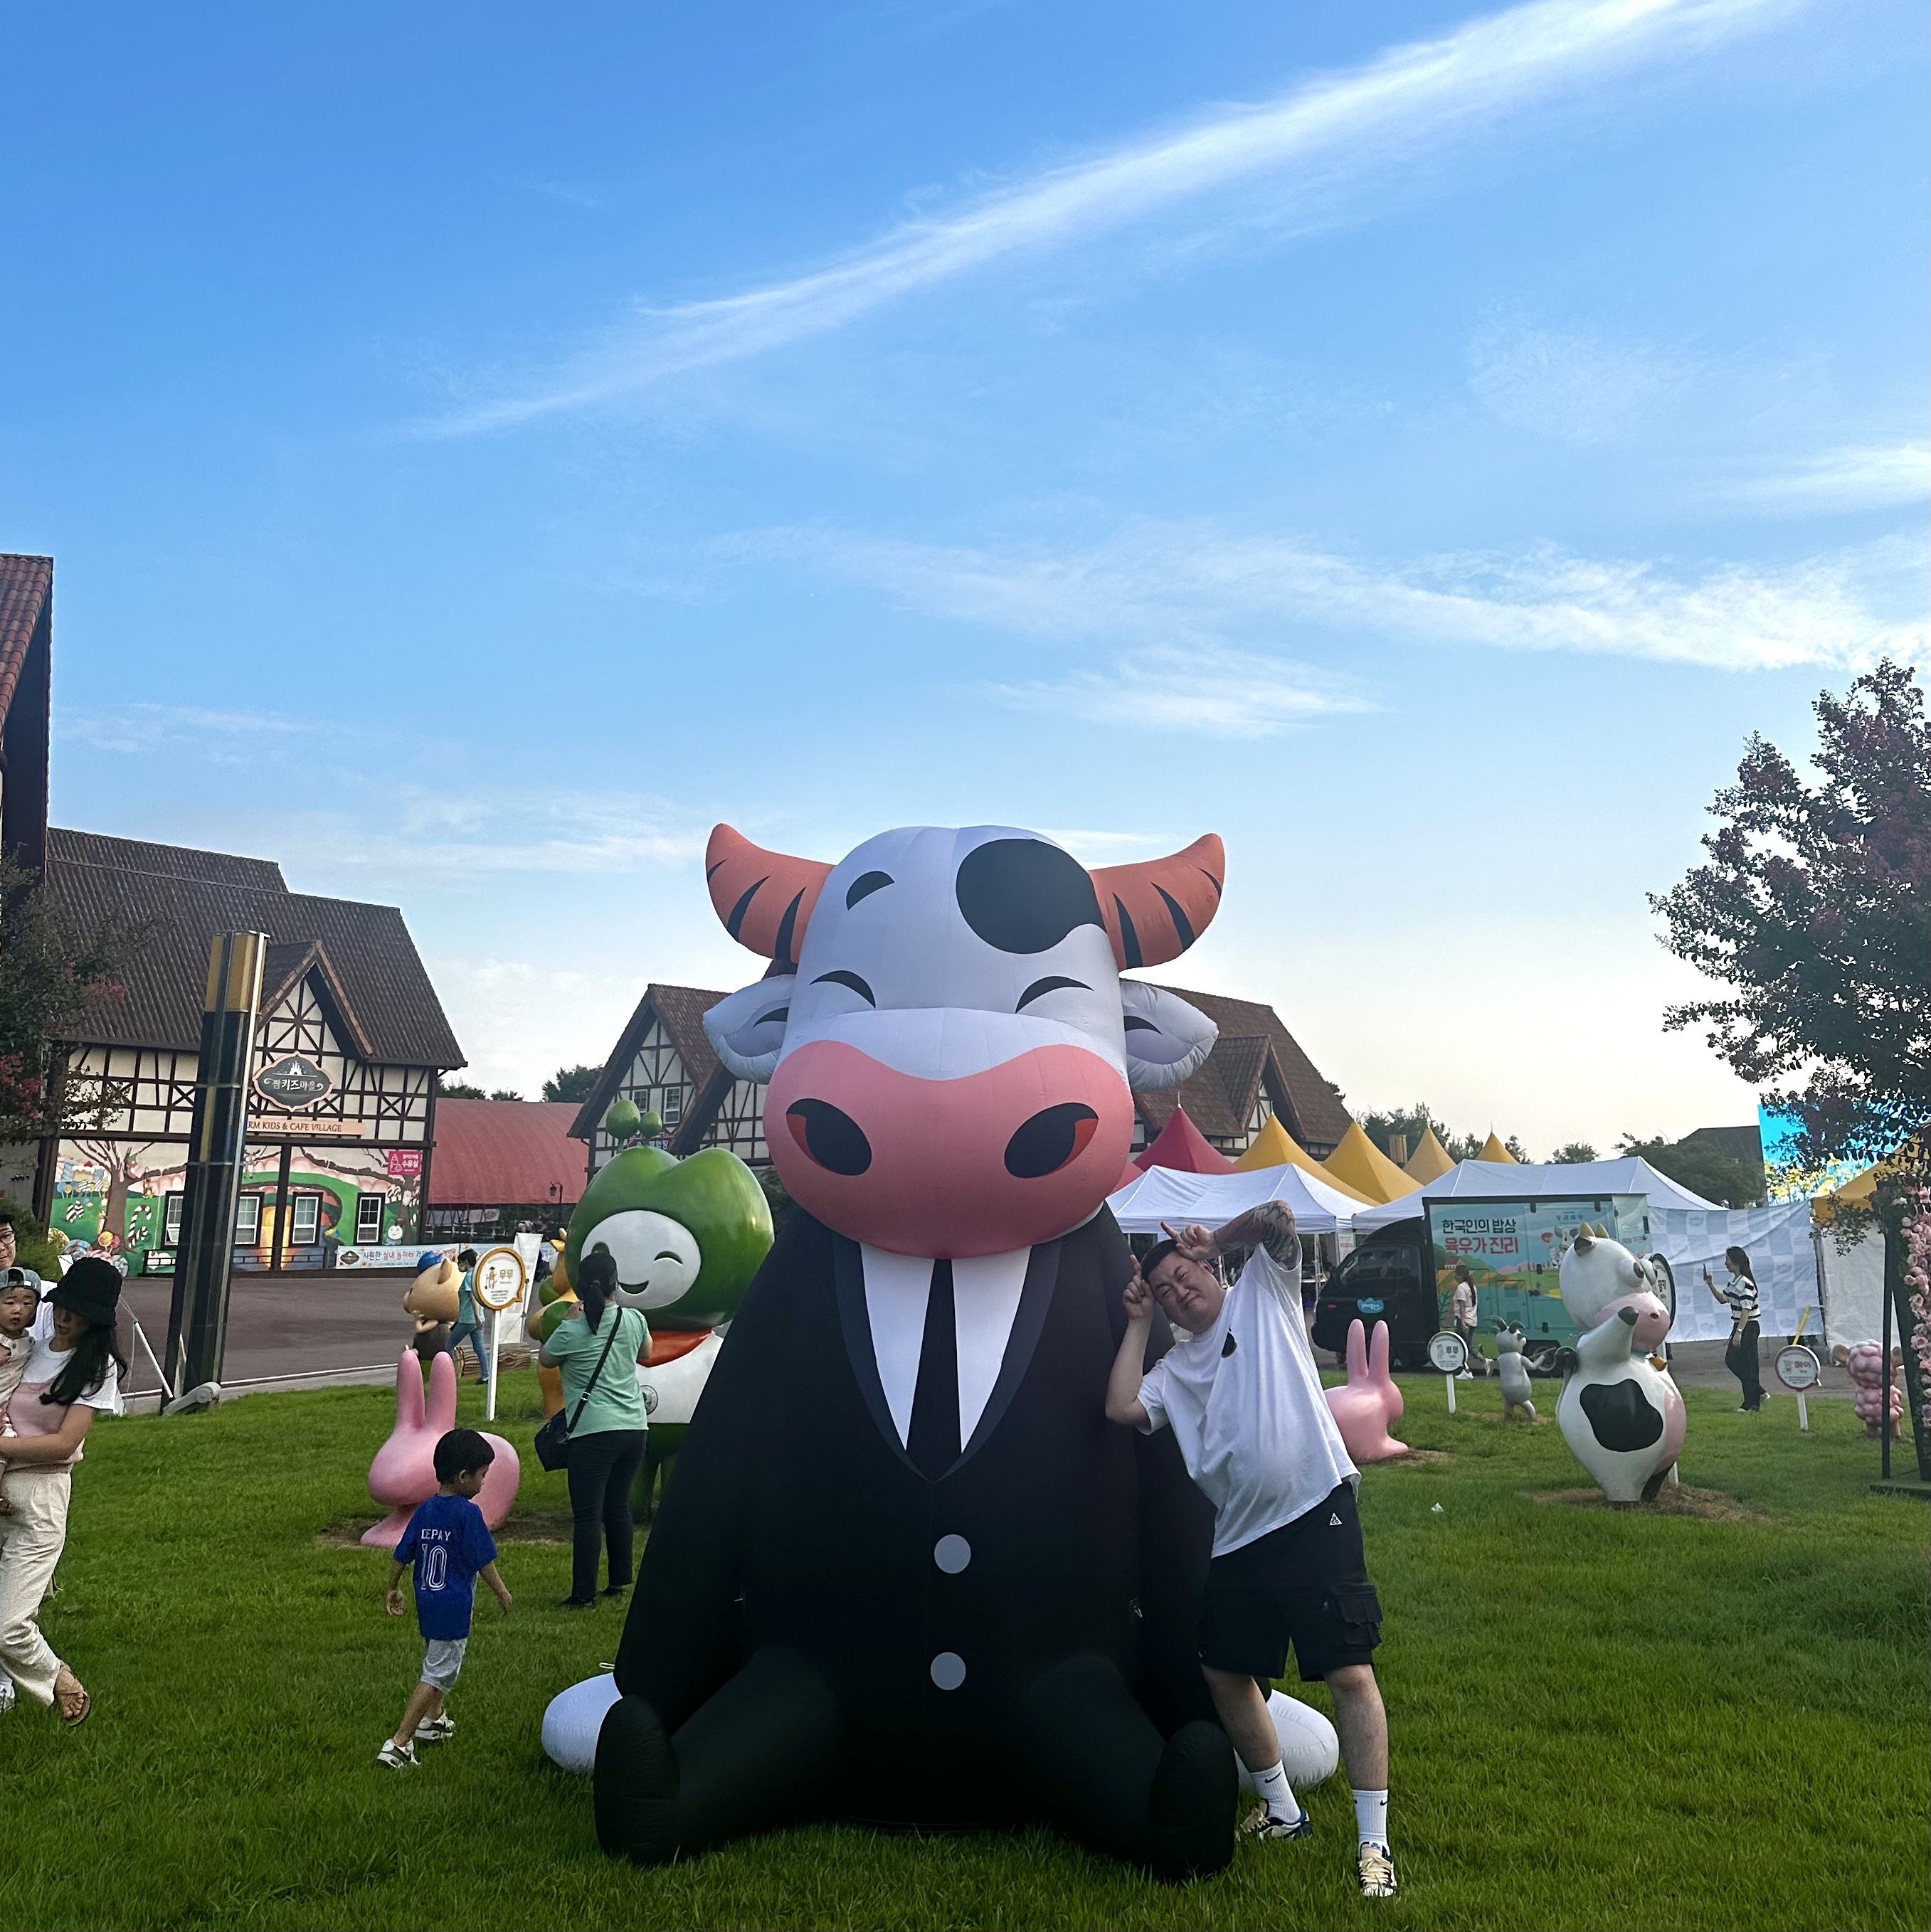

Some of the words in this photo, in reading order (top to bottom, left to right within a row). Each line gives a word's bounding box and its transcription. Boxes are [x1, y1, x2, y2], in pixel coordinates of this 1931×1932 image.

[272, 1078, 317, 1091] 팜키즈마을
[262, 1121, 281, 1130] KIDS
[290, 1122, 310, 1131] CAFE
[311, 1123, 342, 1132] VILLAGE
[1441, 1219, 1491, 1234] 한국인의
[1491, 1219, 1517, 1233] 밥상
[1444, 1237, 1488, 1254] 육우가
[1488, 1237, 1519, 1254] 진리
[363, 1251, 381, 1261] 시원한
[383, 1251, 395, 1261] 실내
[420, 1543, 448, 1591] 10
